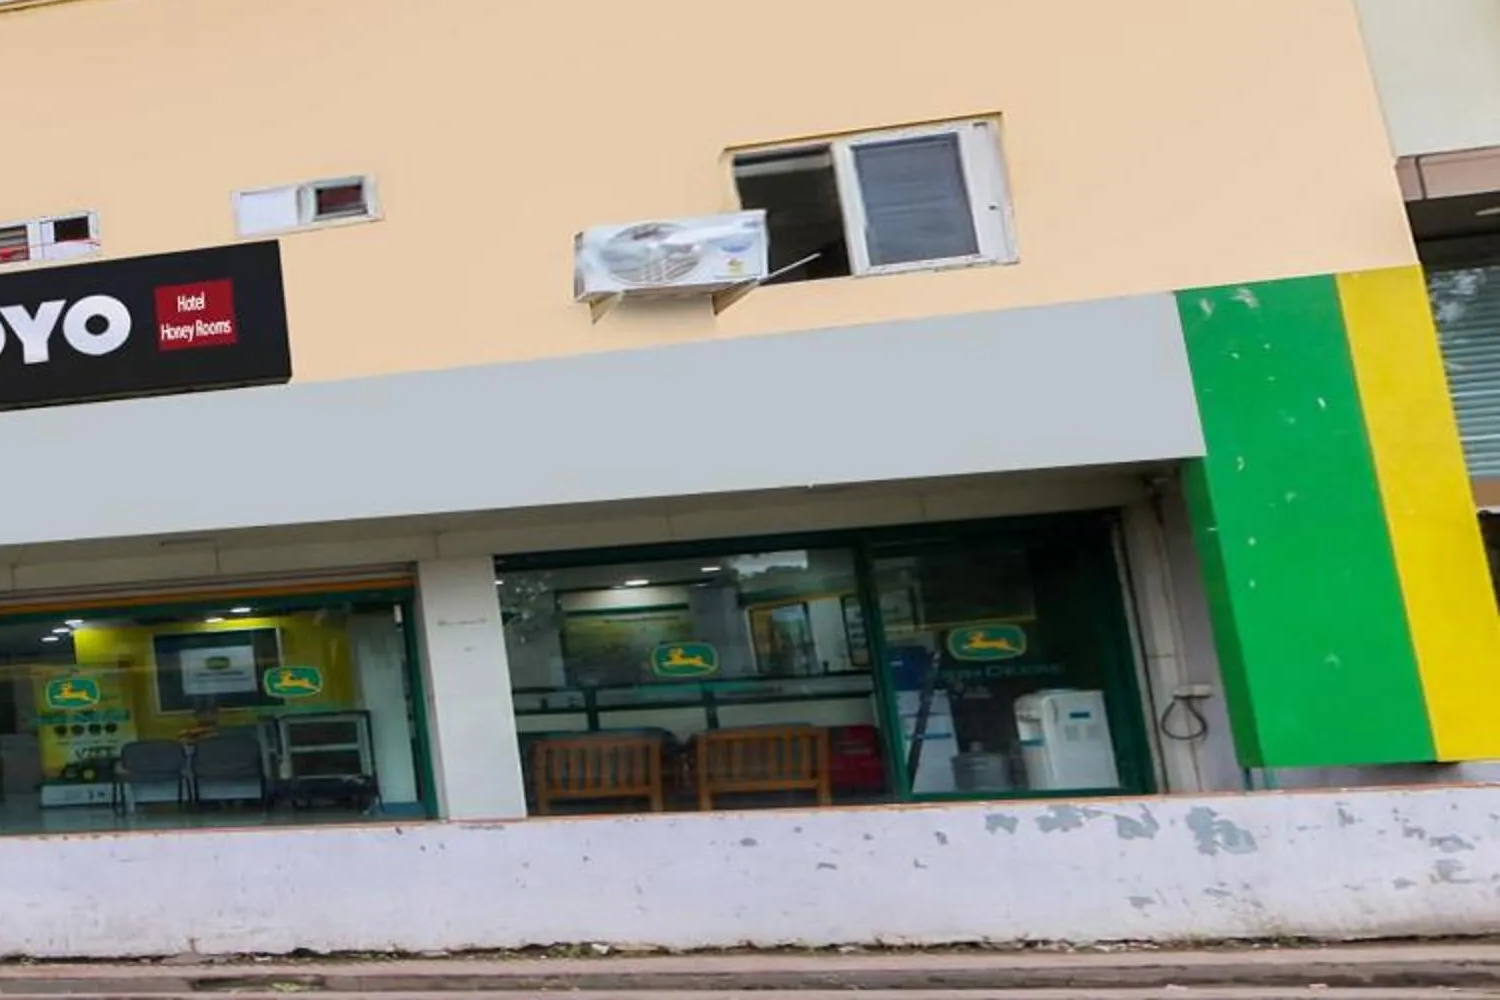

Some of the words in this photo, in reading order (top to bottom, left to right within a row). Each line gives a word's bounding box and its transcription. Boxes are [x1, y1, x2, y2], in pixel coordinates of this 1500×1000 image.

[177, 291, 205, 312] Hotel
[160, 322, 195, 342] Honey
[195, 319, 232, 336] Rooms
